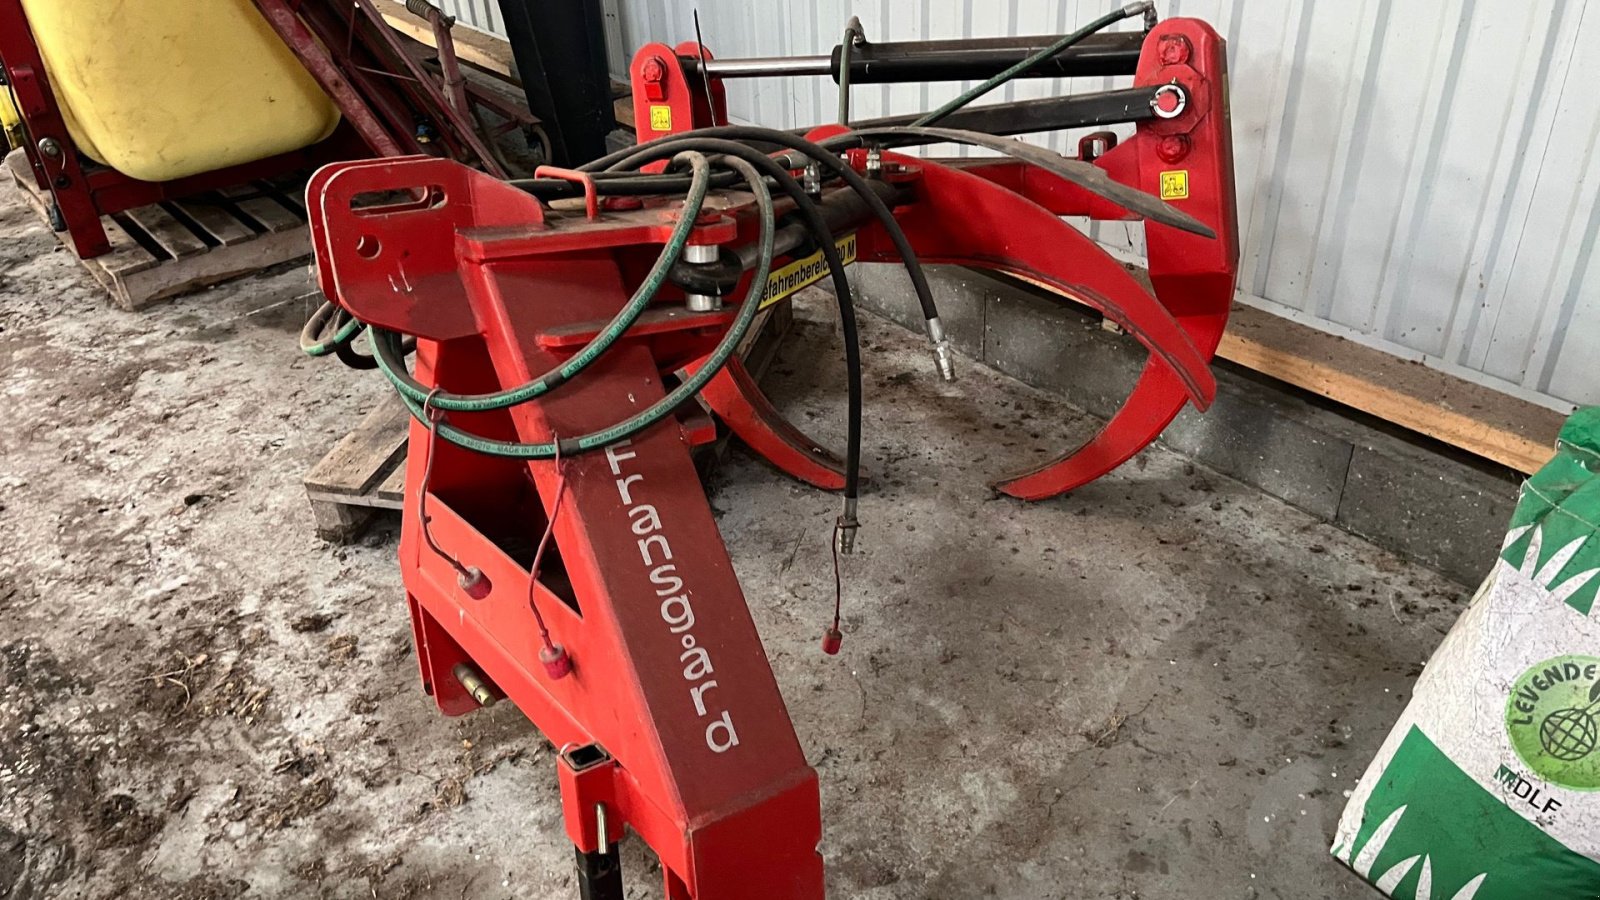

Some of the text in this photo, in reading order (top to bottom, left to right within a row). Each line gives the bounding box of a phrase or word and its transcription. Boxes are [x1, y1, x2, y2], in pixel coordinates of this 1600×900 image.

[761, 253, 829, 303] efahrenbereic
[847, 239, 855, 259] M
[530, 444, 555, 454] ITALY
[604, 439, 740, 753] Fransgård
[1513, 662, 1597, 725] LEVENDE
[1513, 778, 1562, 813] DLF
